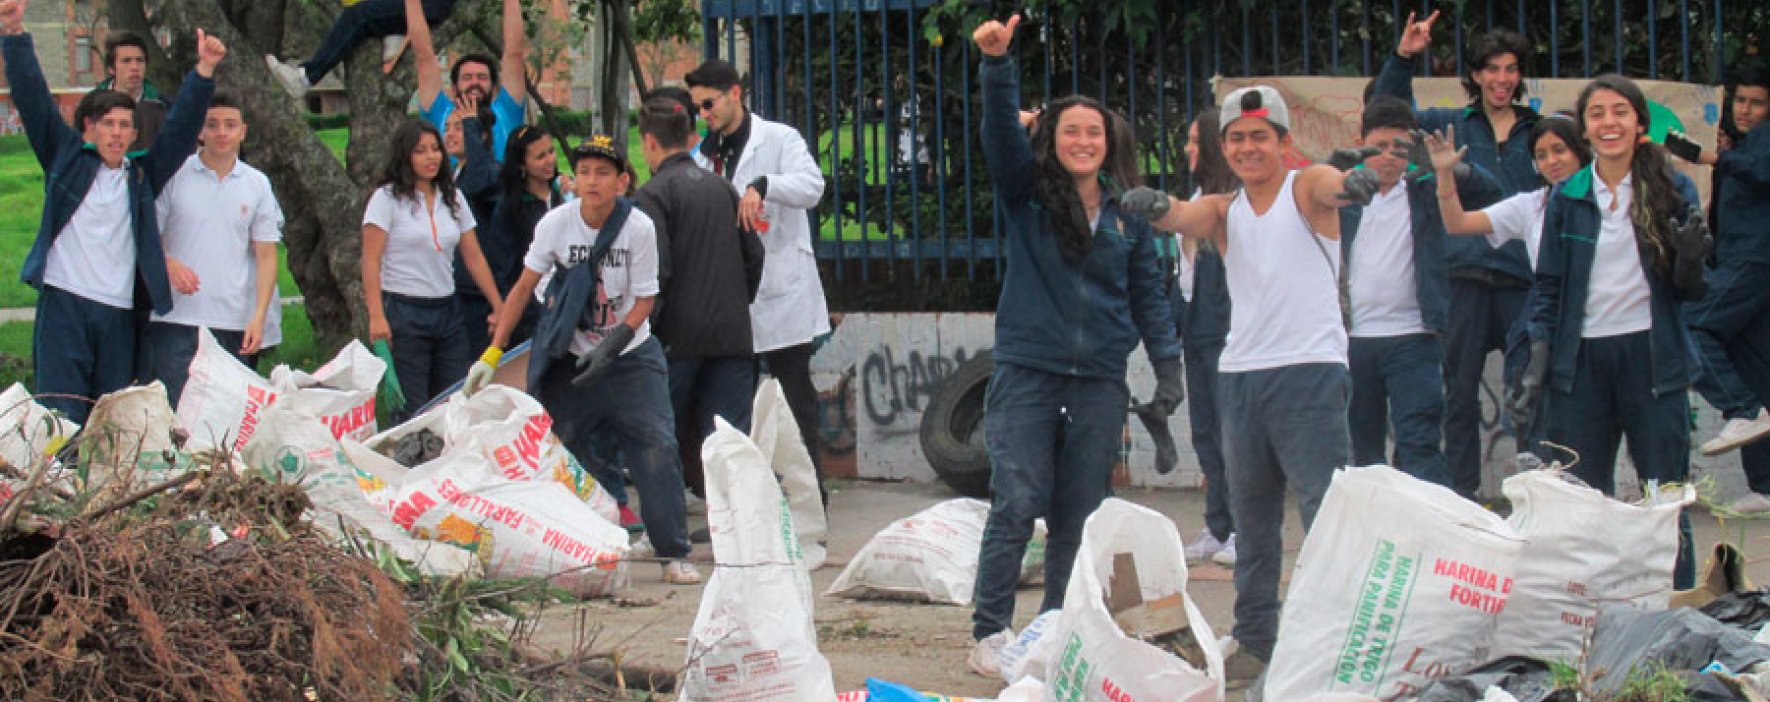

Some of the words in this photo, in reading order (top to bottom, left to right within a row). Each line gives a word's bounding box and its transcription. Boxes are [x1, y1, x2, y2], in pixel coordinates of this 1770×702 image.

[542, 527, 597, 564] HARINA
[1372, 539, 1395, 580] PARA
[1383, 555, 1412, 609] HARINA
[1434, 557, 1498, 592] HARINA
[1450, 584, 1507, 615] FORTIF
[1377, 613, 1394, 633] DE
[1361, 637, 1387, 682] TRIGO
